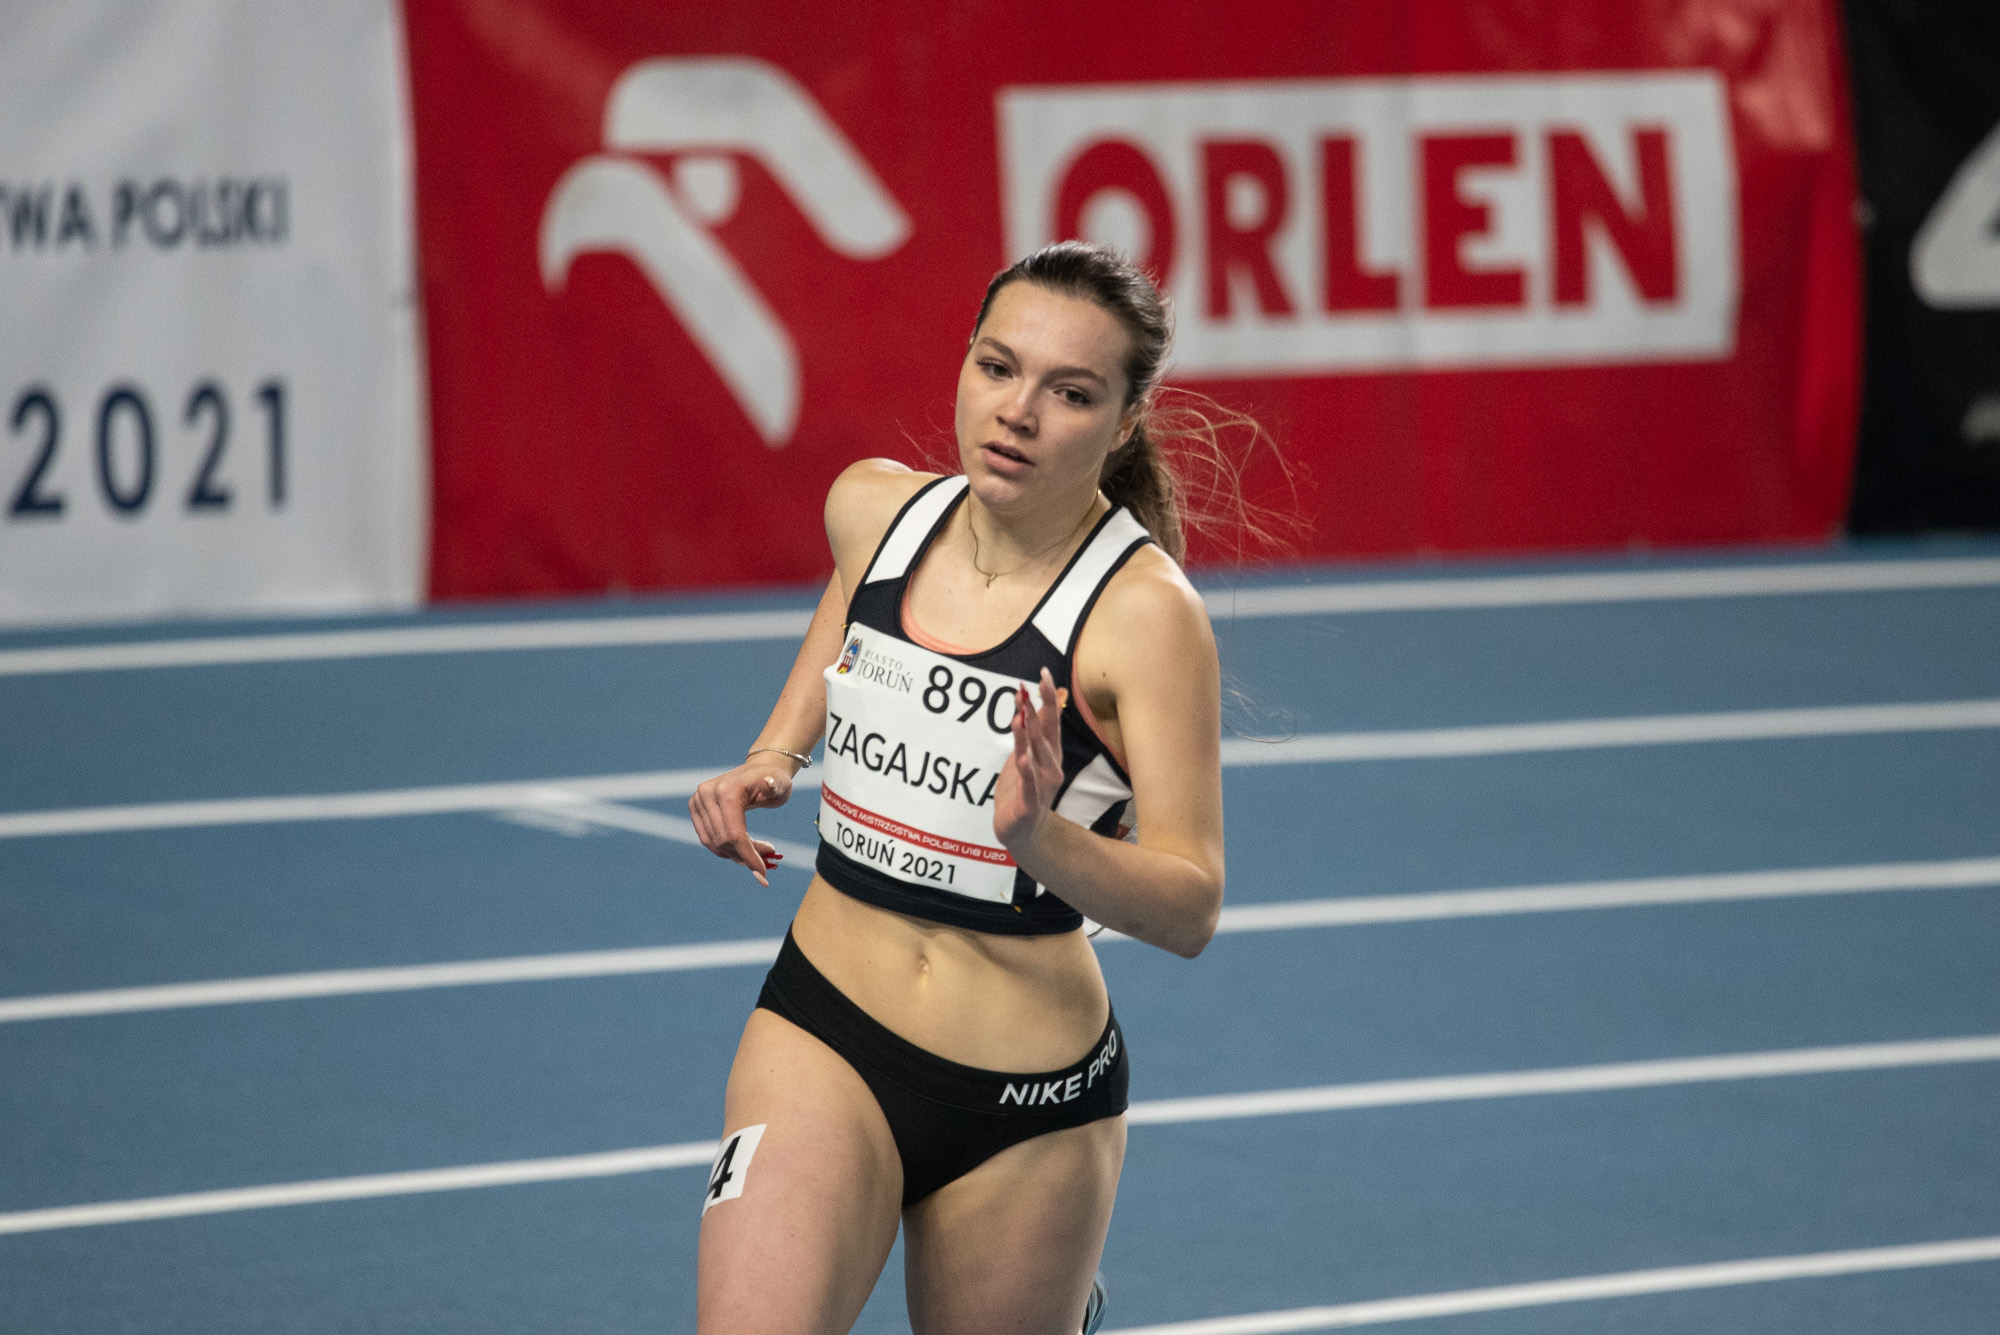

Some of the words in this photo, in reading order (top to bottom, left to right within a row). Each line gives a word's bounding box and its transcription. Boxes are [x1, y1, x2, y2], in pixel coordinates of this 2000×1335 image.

[0, 180, 97, 250] WA
[111, 176, 290, 250] POLSKI
[1050, 121, 1682, 324] ORLEN
[6, 374, 290, 522] 2021
[857, 658, 914, 694] TORUŃ
[864, 649, 903, 671] MIASTO
[922, 665, 1018, 735] 890
[836, 821, 896, 867] TORUŃ
[899, 852, 956, 885] 2021
[858, 811, 920, 842] MISTRZOSTWA
[921, 835, 959, 852] POLSKI
[983, 850, 1007, 862] U20
[999, 1071, 1083, 1106] NIKE
[1086, 1028, 1118, 1090] PRO
[707, 1134, 742, 1201] 4
